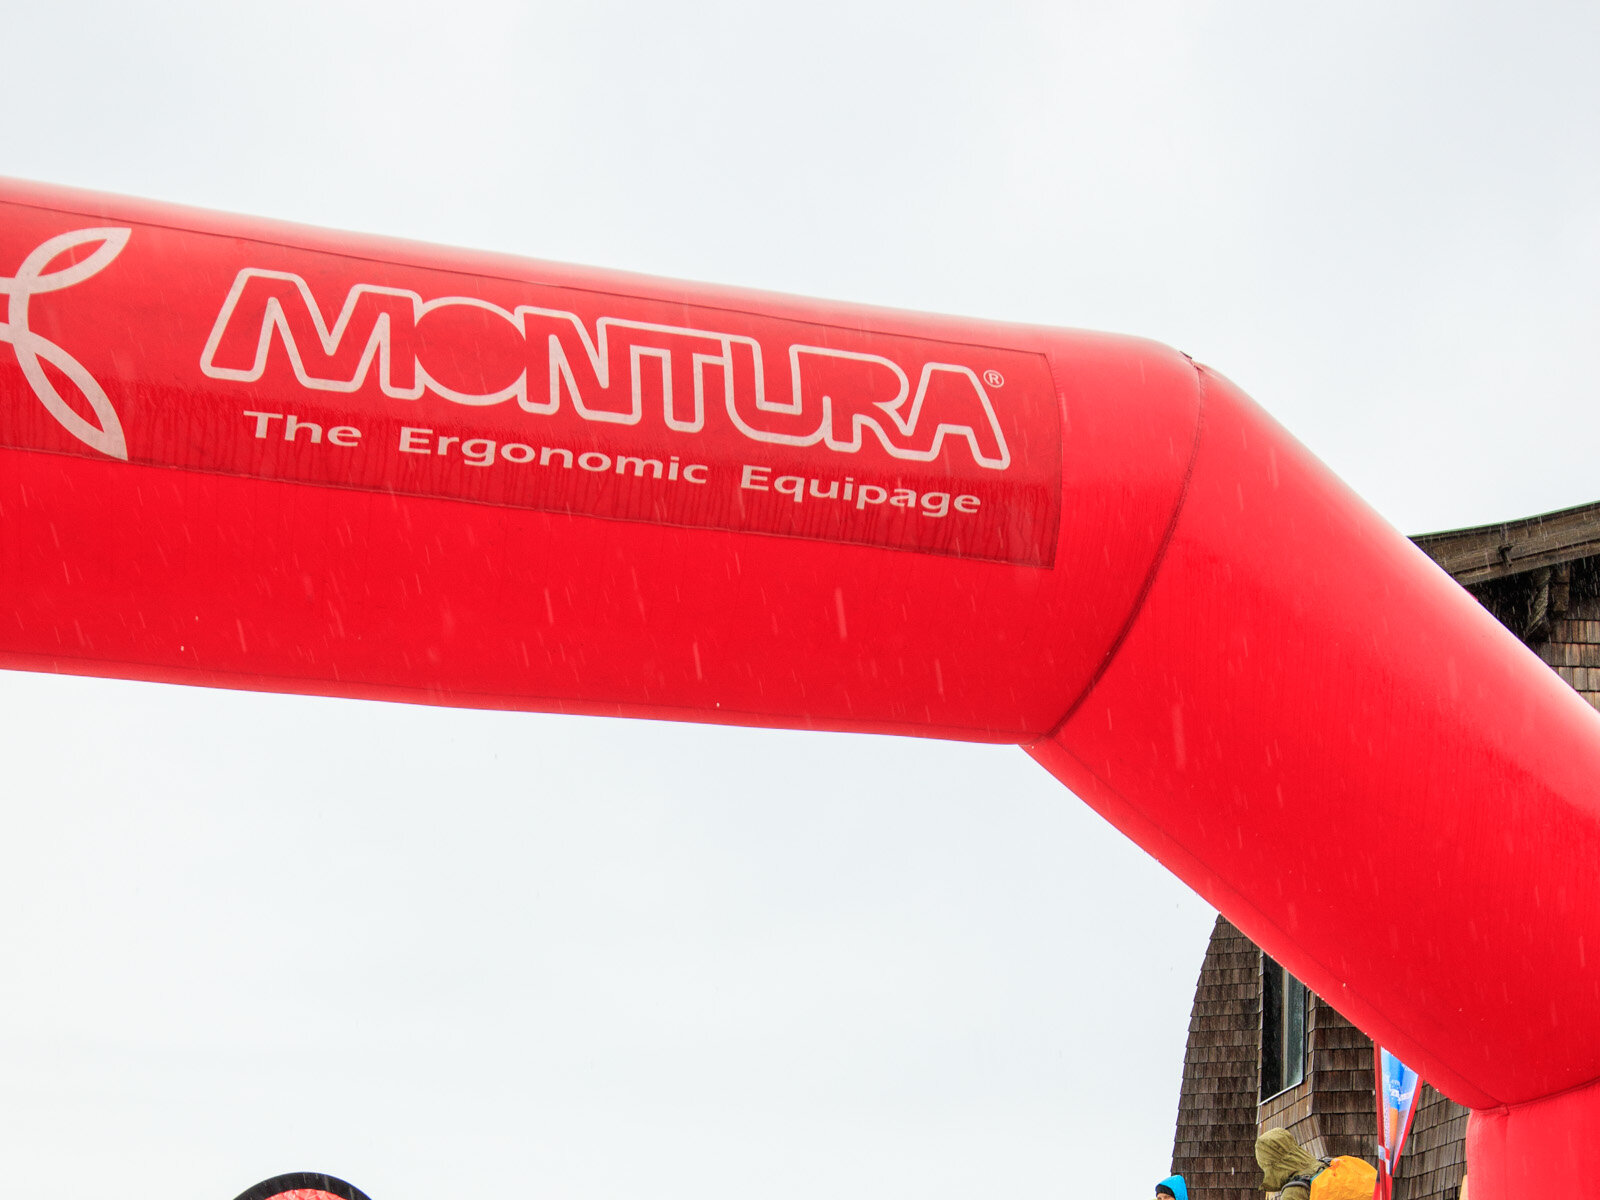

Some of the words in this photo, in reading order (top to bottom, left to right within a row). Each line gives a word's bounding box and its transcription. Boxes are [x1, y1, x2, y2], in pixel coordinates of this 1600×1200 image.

[200, 267, 1011, 470] MONTURA
[243, 409, 362, 447] The
[399, 426, 708, 485] Ergonomic
[740, 466, 981, 518] Equipage
